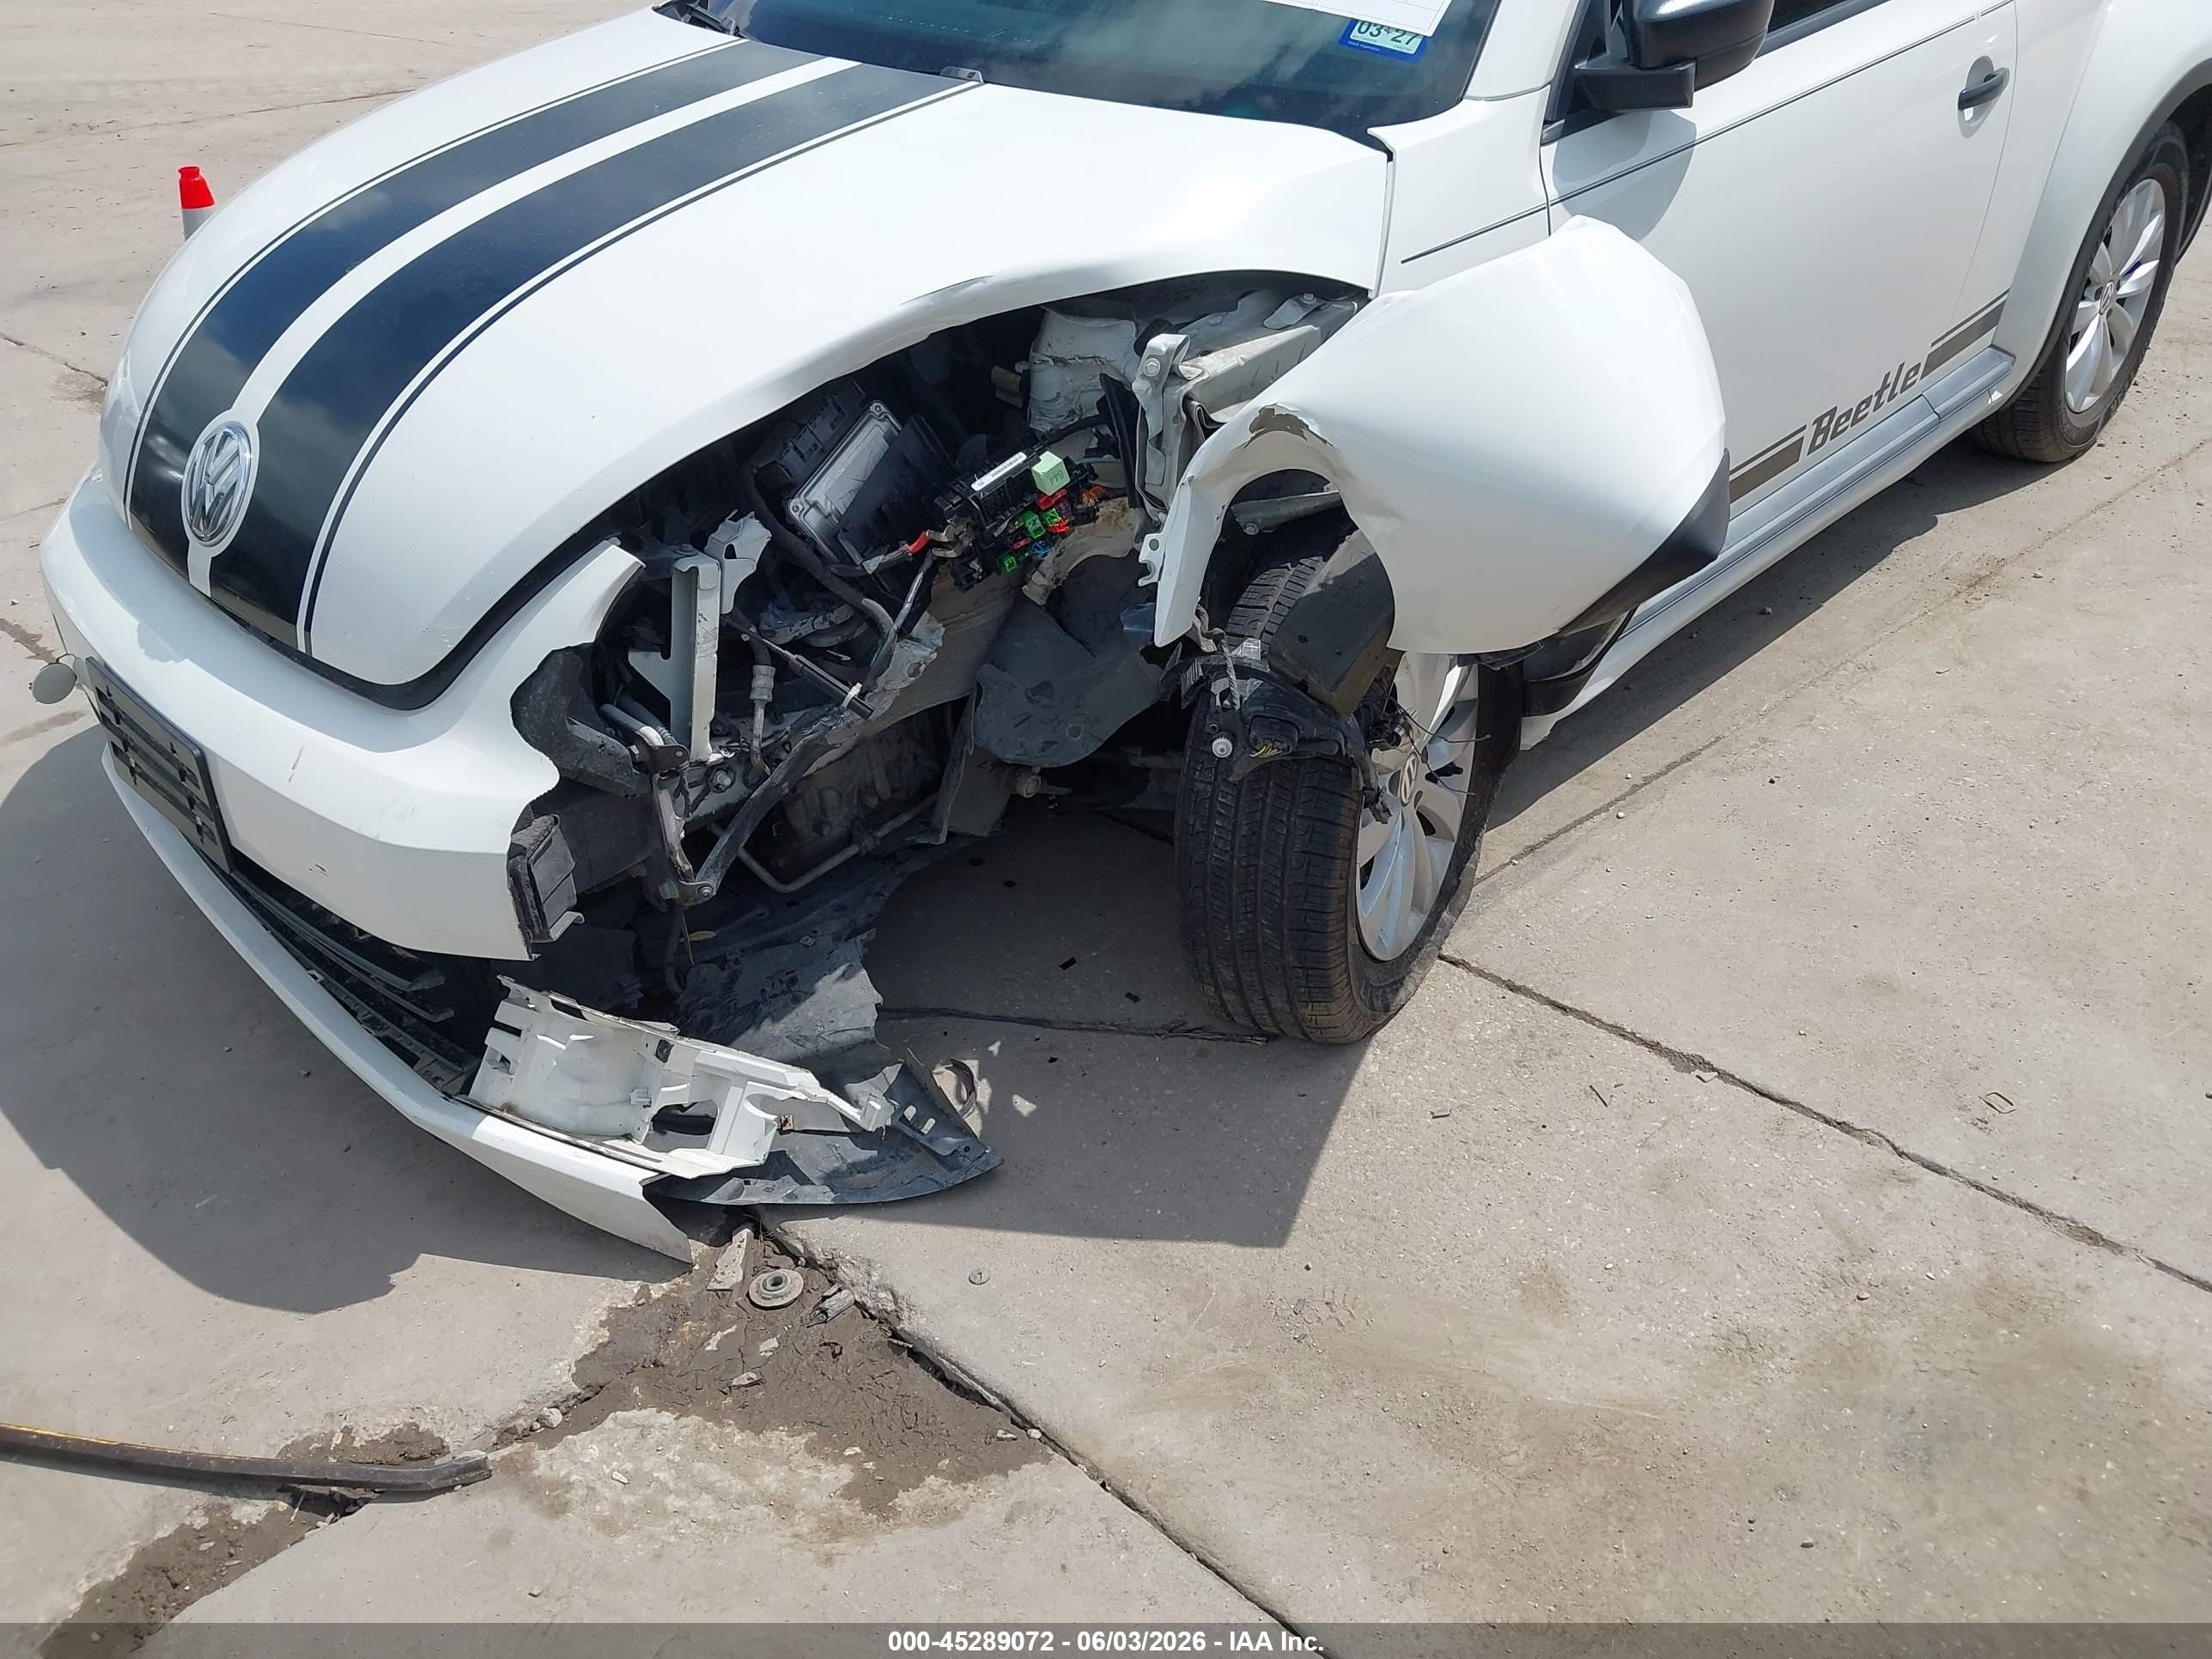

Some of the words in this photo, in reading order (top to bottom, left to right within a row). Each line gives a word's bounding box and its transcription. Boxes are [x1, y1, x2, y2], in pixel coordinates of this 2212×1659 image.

[1357, 21, 1382, 38] 03
[1390, 28, 1419, 46] 27
[1806, 361, 1921, 457] Beetle
